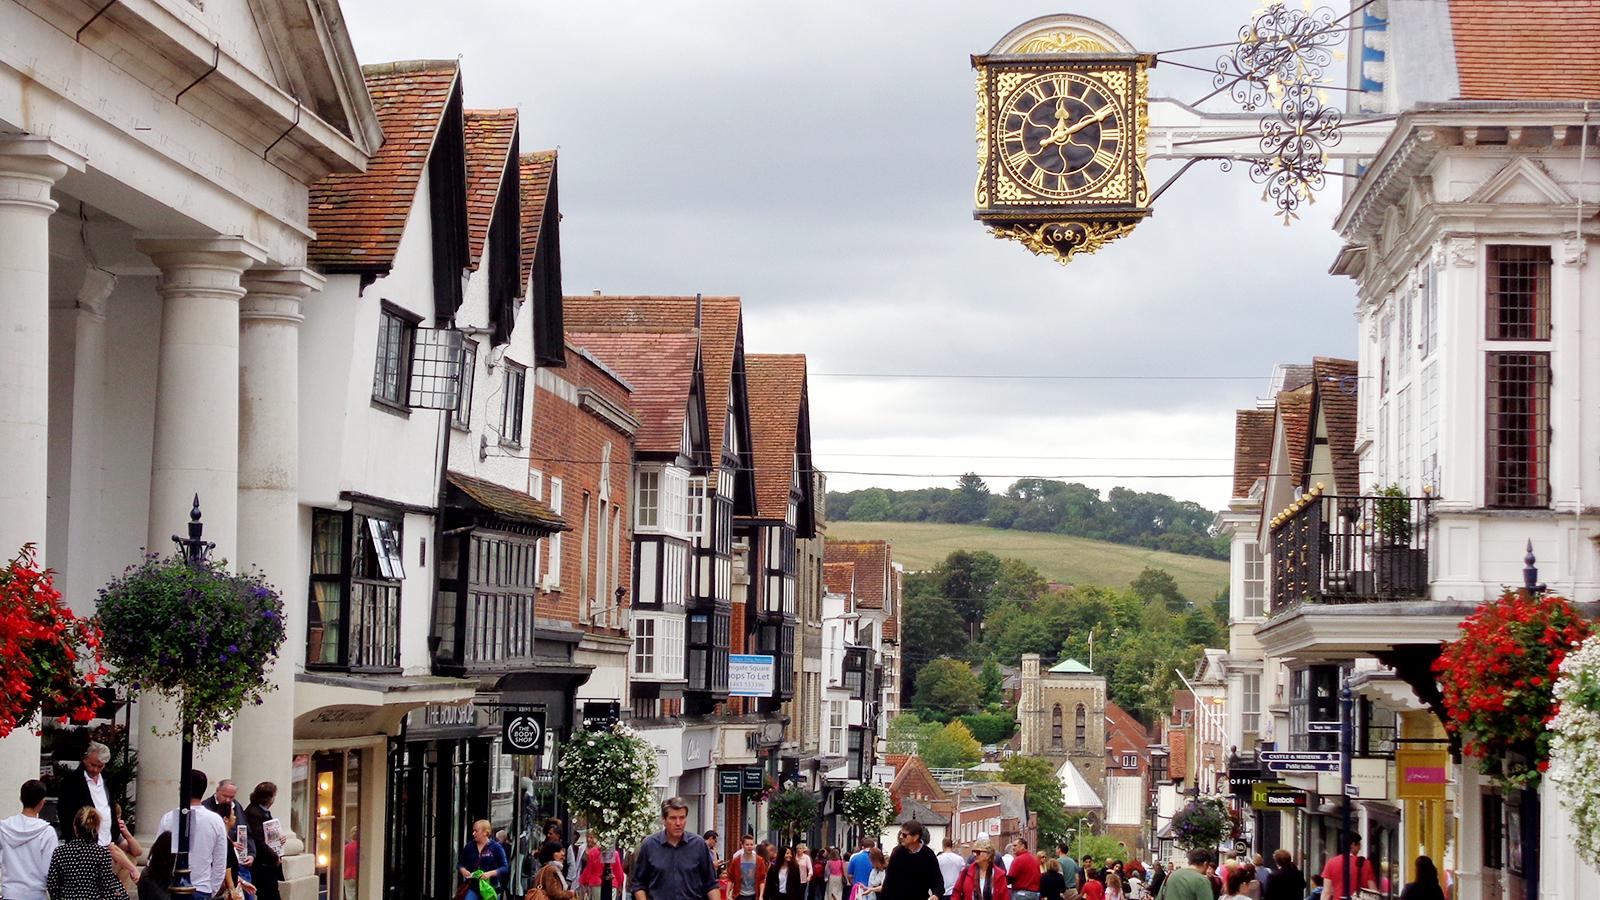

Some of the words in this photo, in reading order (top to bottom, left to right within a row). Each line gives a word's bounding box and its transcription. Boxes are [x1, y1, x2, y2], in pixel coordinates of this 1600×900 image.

[1046, 229, 1081, 244] 1683
[746, 672, 756, 680] To
[757, 672, 770, 680] Let
[1268, 796, 1295, 804] Reebok
